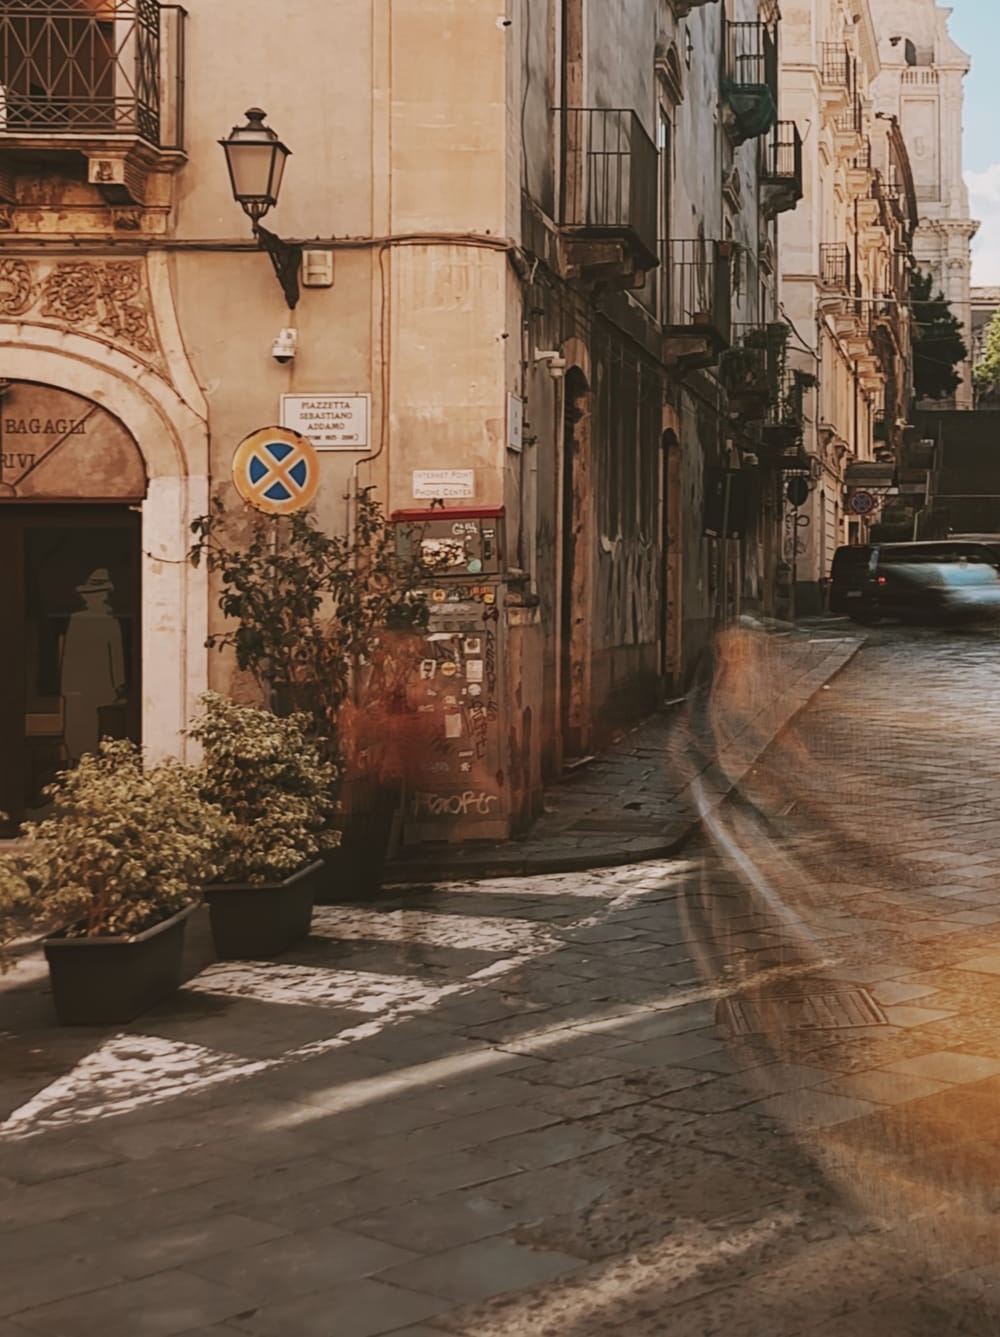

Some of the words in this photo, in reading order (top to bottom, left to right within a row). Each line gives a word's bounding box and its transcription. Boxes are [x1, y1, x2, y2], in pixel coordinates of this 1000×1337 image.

[301, 401, 351, 410] PIAZZETTA
[299, 412, 353, 420] SEBASTIANO
[5, 418, 87, 435] BAGAGLI
[307, 422, 345, 431] ADDAMO
